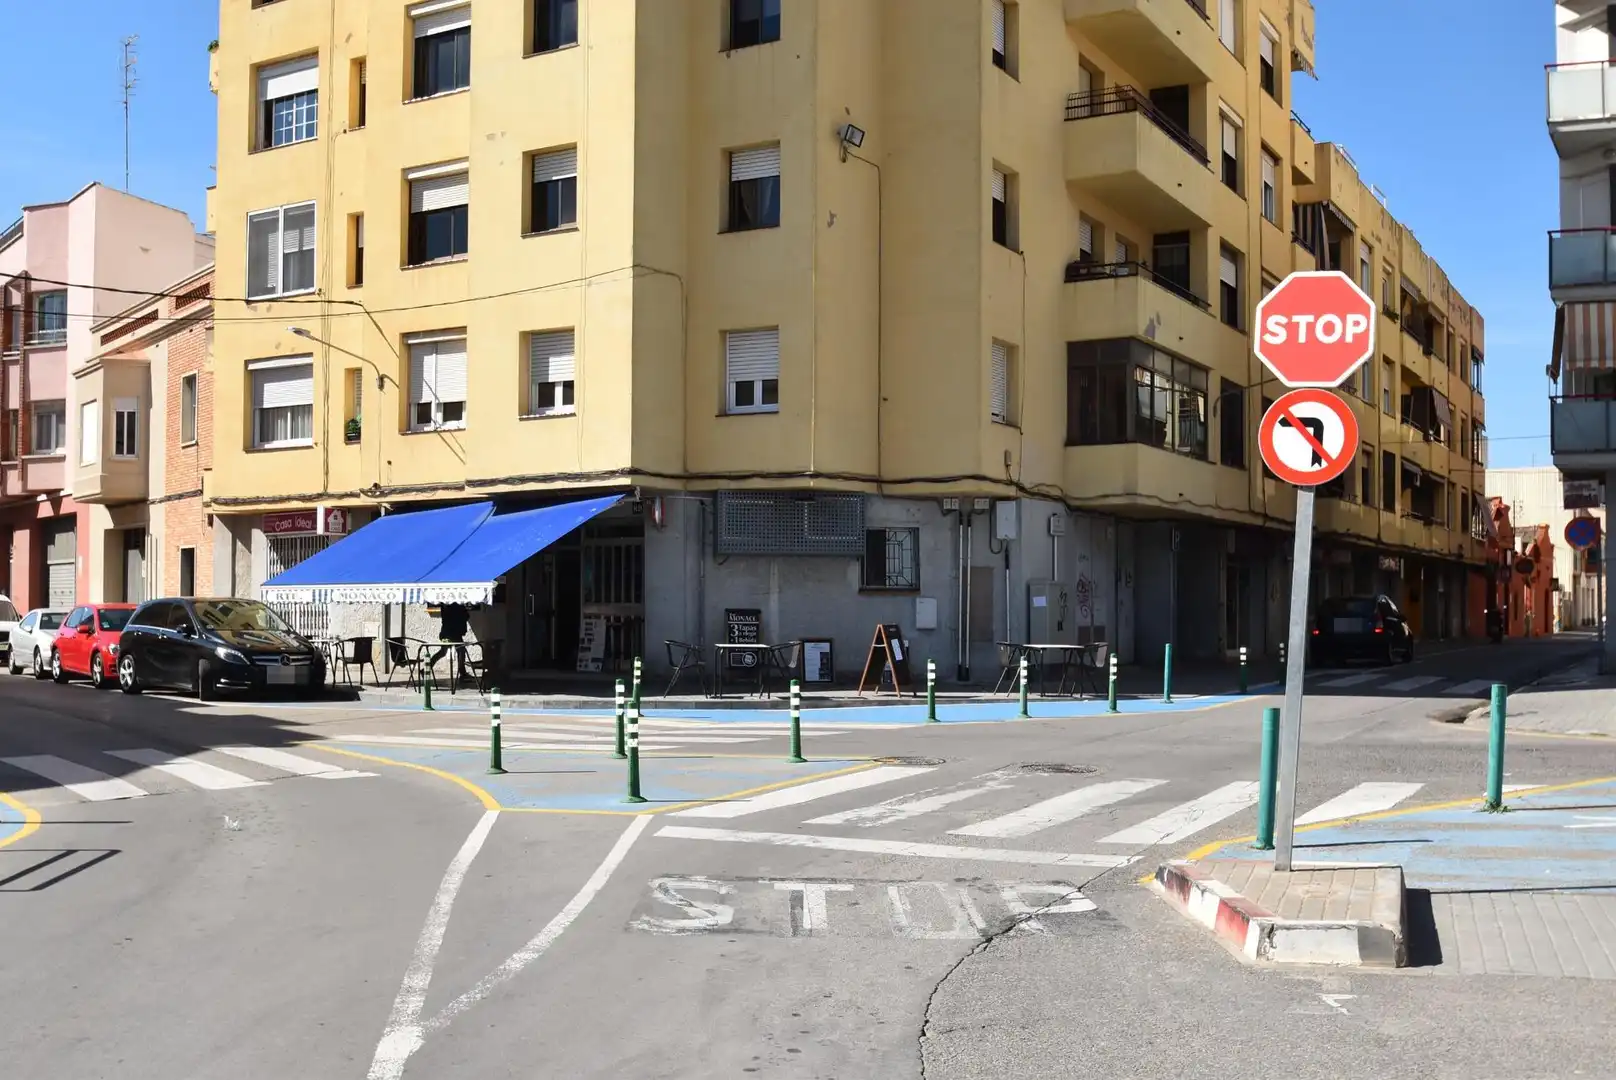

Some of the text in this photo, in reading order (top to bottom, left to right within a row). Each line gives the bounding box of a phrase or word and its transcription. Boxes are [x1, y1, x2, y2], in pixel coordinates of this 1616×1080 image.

[1262, 313, 1368, 345] STOP
[339, 591, 397, 600] MONACO
[436, 590, 468, 600] BAR
[730, 624, 739, 637] 3
